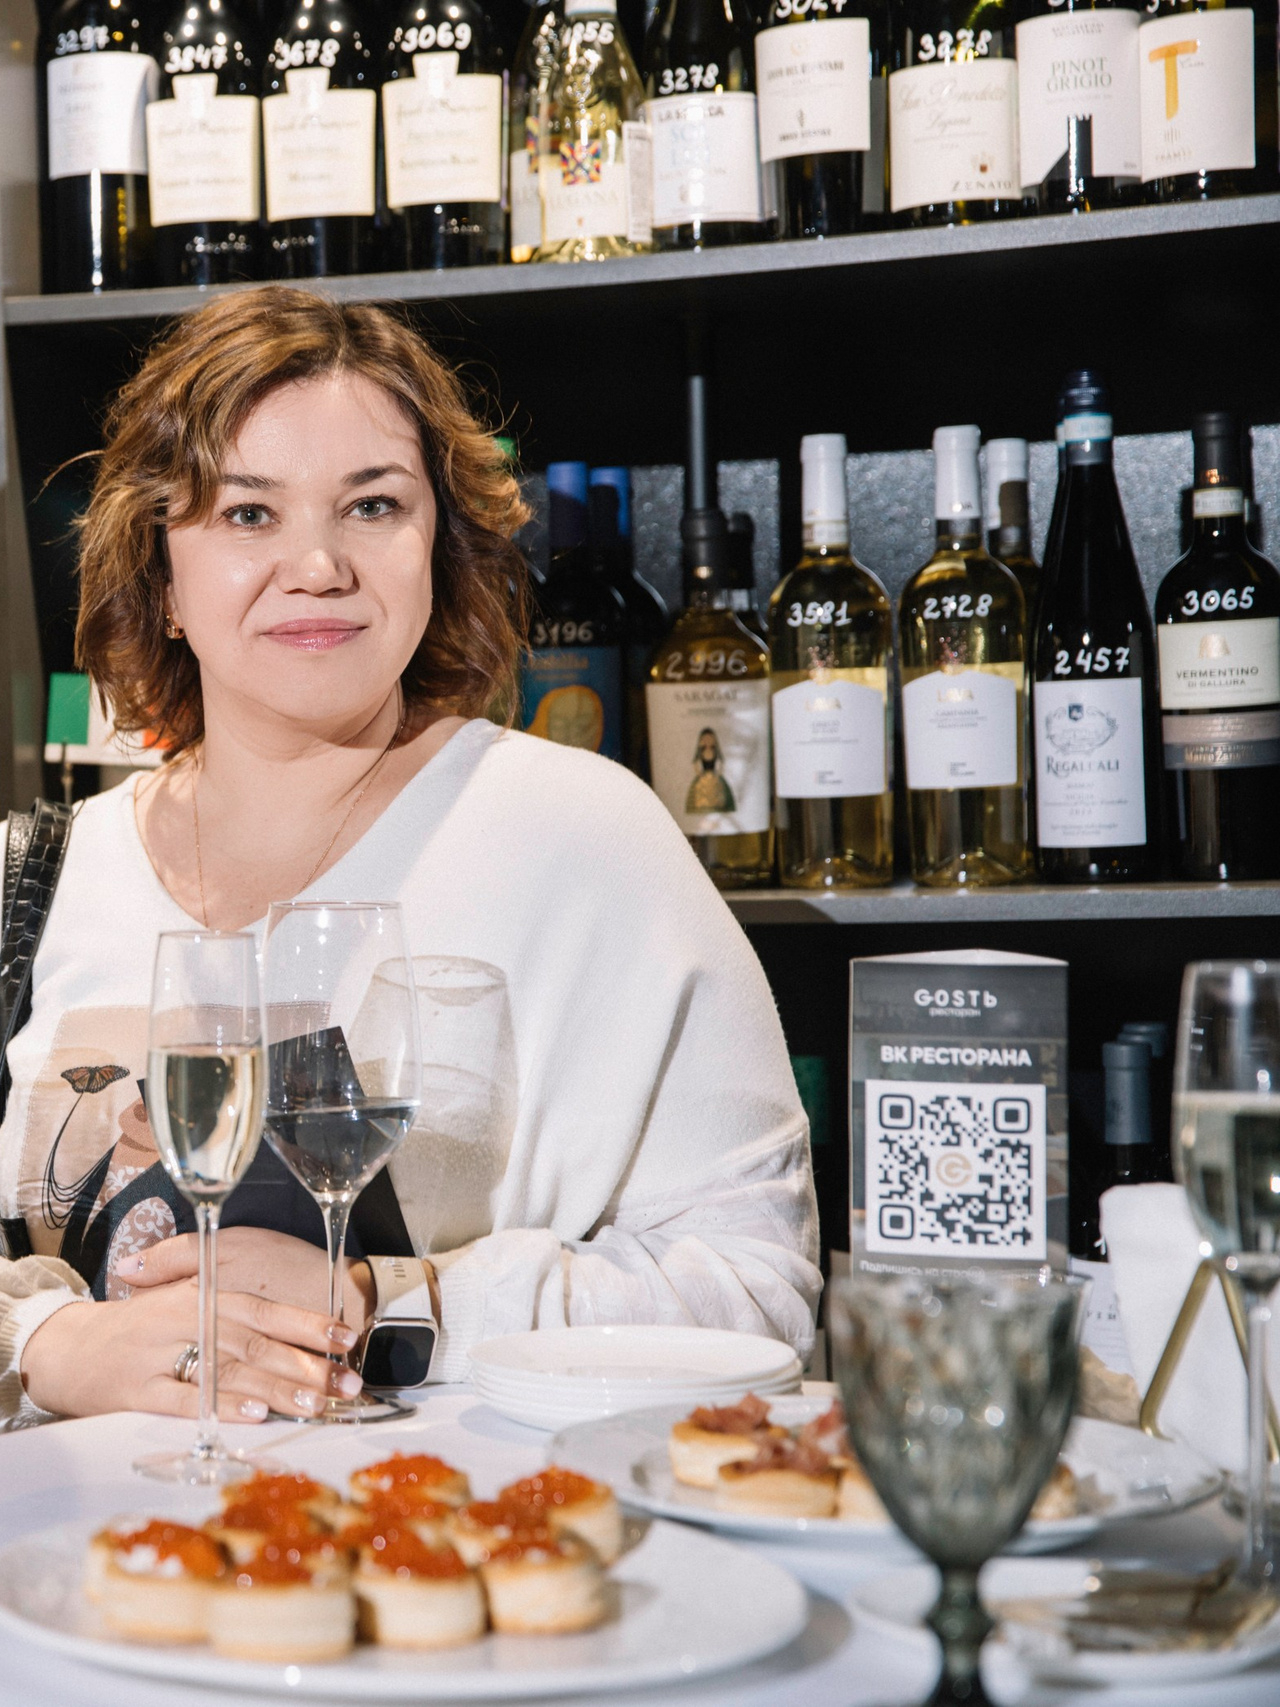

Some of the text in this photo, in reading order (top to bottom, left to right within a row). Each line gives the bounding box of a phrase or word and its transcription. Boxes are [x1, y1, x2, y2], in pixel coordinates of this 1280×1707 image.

[400, 21, 472, 53] 3069
[658, 63, 719, 95] 3278
[1050, 57, 1108, 77] PINOT
[1046, 75, 1113, 93] GRIGIO
[786, 600, 853, 628] 3581
[922, 593, 993, 620] 2728
[1181, 586, 1255, 616] 3065
[665, 649, 745, 680] 2996
[1054, 647, 1130, 675] 2457
[1176, 666, 1259, 680] VERMENTINO
[1199, 678, 1246, 688] GALLURA
[880, 1045, 1032, 1066] ВК РЕСТОРАНА
[859, 1259, 922, 1276] Подпишись
